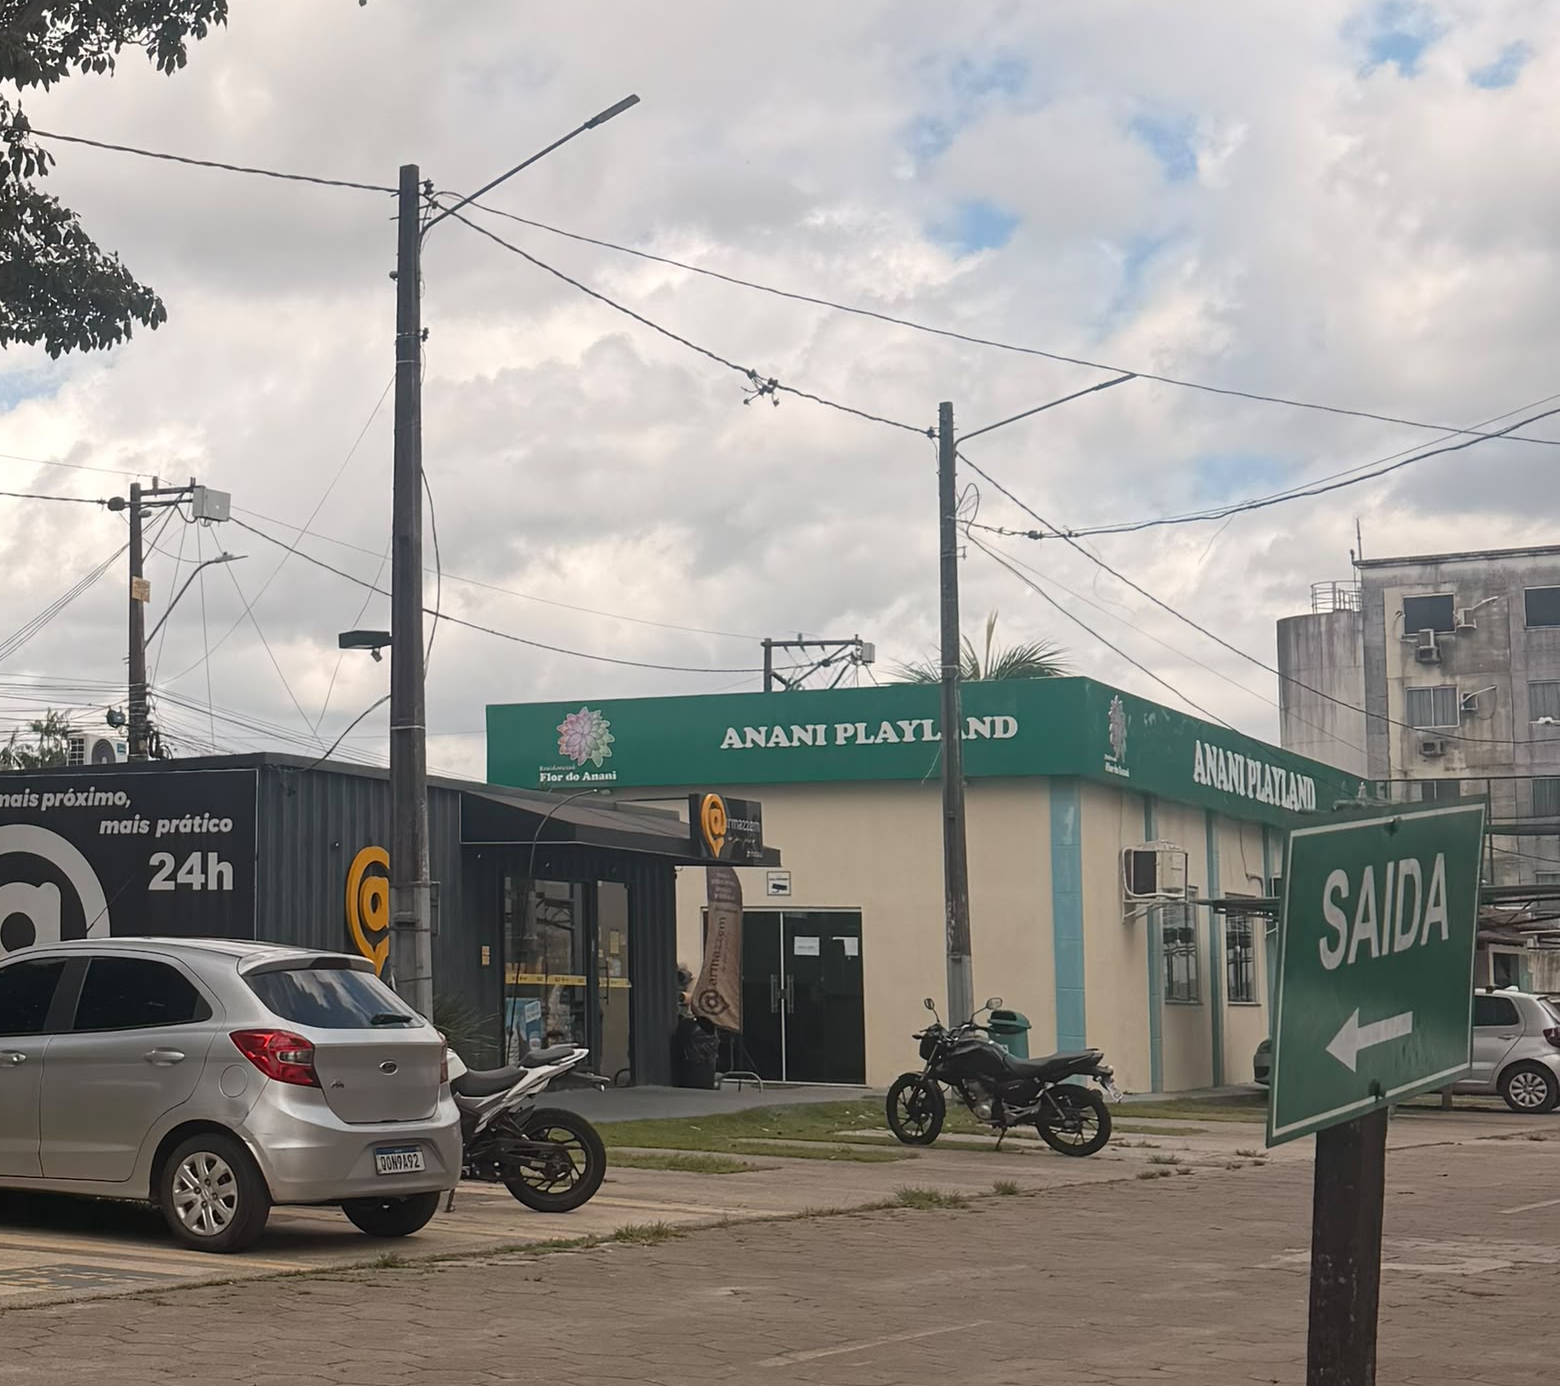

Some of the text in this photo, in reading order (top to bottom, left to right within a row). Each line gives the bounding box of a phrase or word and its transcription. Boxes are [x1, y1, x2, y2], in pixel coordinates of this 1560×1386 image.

[720, 716, 1018, 749] ANANI PLAYLND
[540, 770, 617, 782] Flor do Anani
[1193, 740, 1316, 812] ANANI PLAYLAND
[41, 786, 131, 811] próximo,
[99, 812, 233, 838] mais prático
[147, 851, 234, 891] 24h
[1319, 852, 1449, 971] SAIDA
